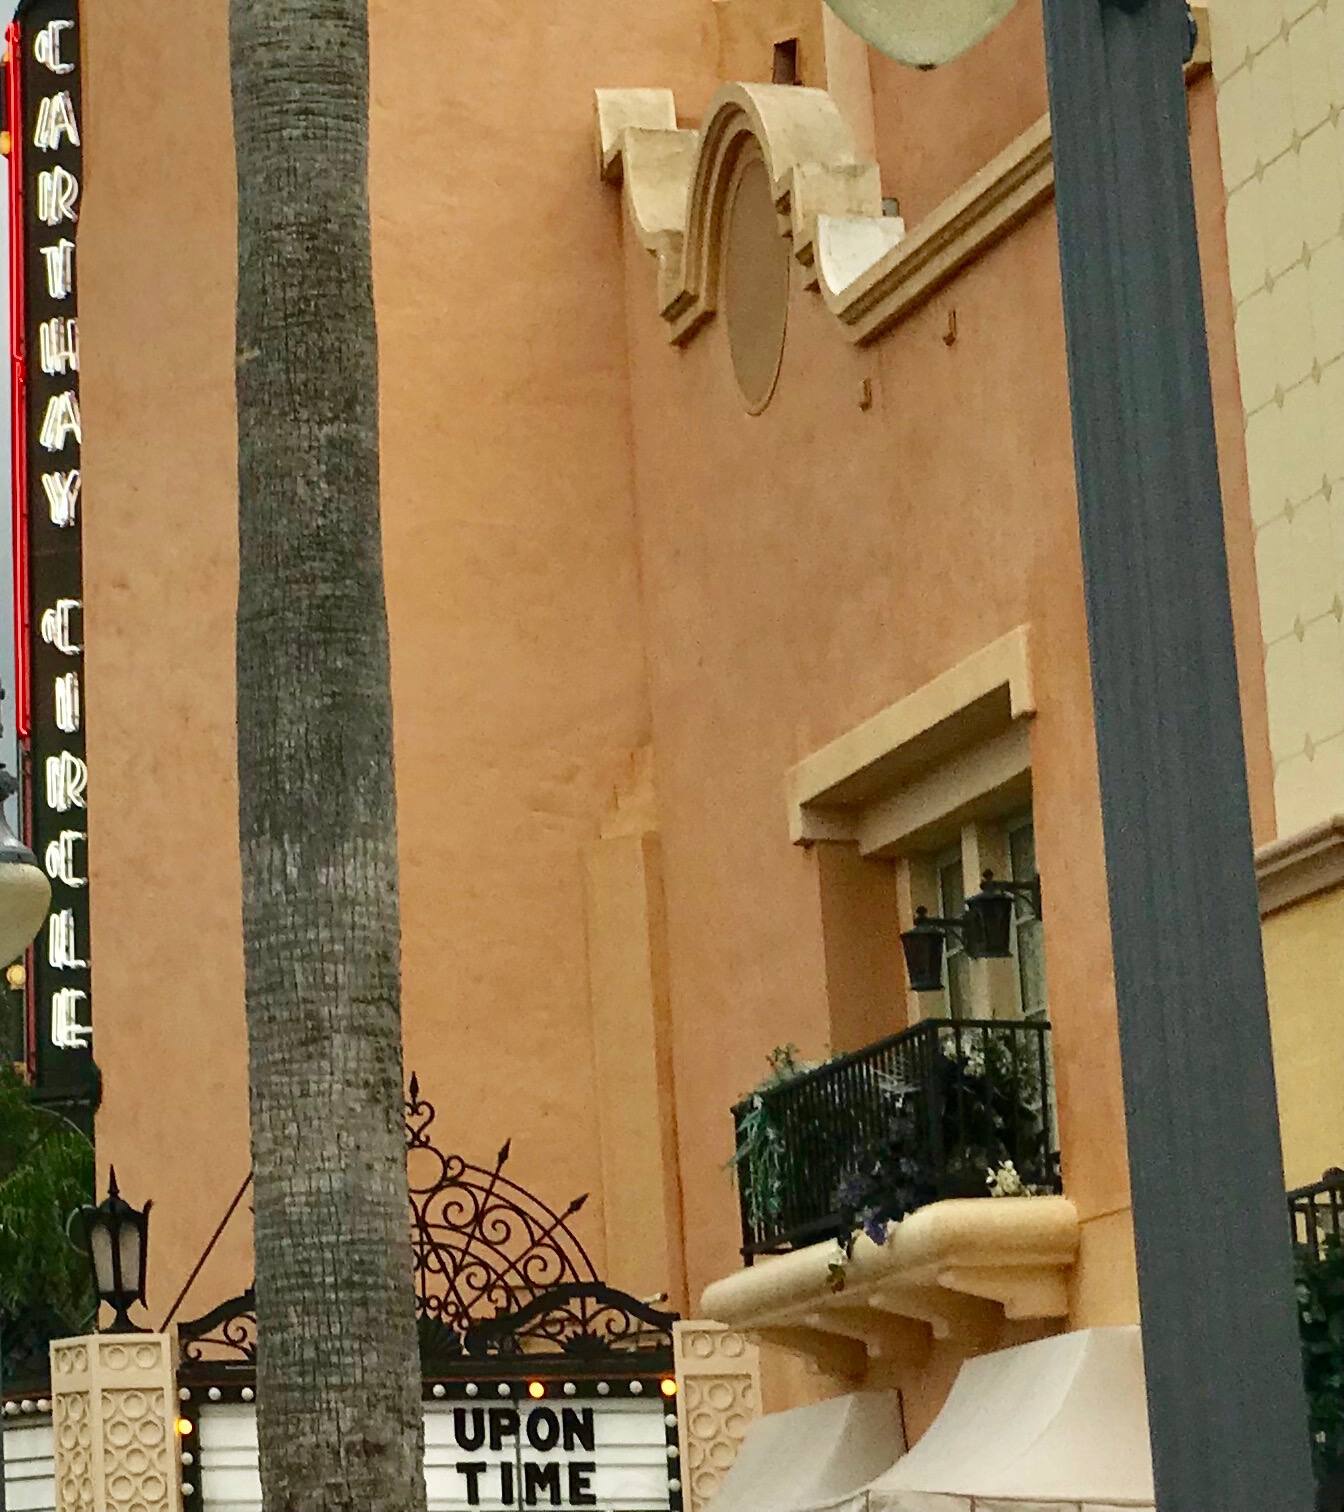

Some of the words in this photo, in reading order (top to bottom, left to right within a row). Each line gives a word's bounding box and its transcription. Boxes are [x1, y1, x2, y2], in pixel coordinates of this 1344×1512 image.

[33, 19, 81, 527] CARTHAY
[41, 598, 92, 1051] CIRCLE
[453, 1406, 595, 1452] UPON
[456, 1461, 597, 1505] TIME
